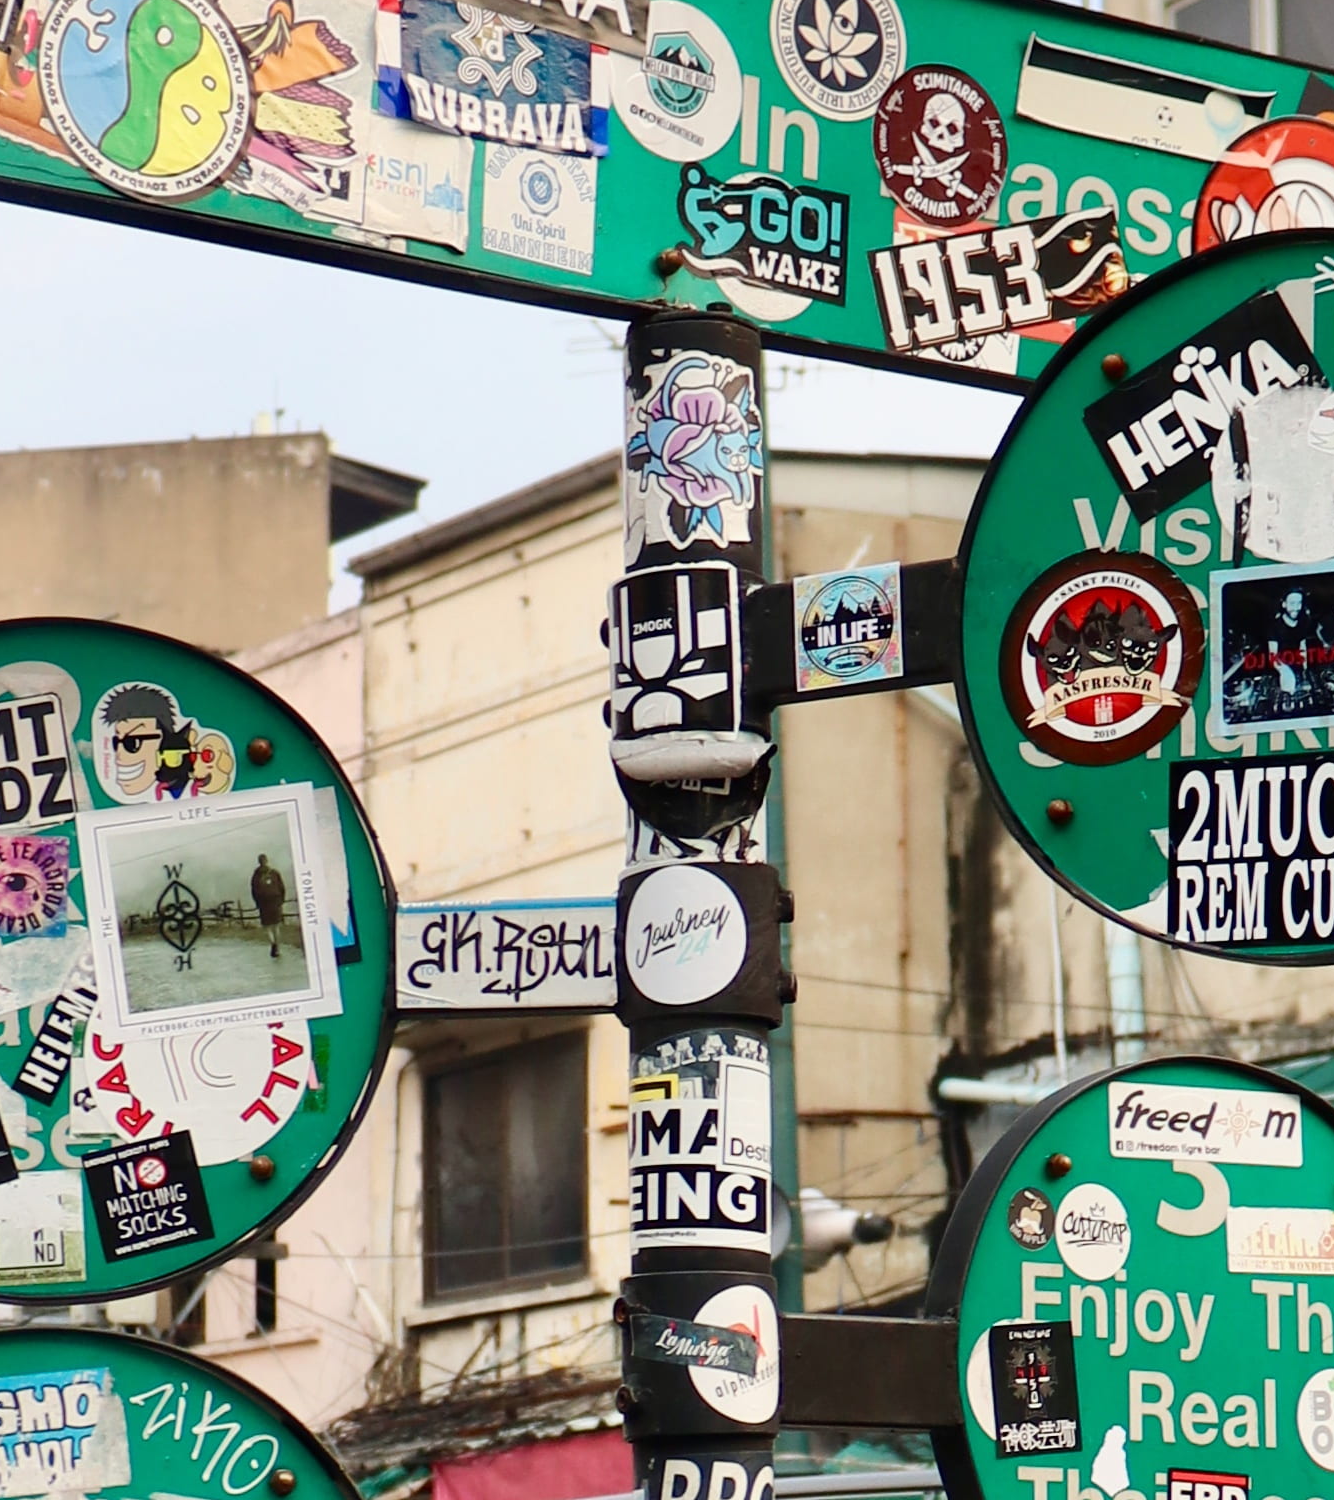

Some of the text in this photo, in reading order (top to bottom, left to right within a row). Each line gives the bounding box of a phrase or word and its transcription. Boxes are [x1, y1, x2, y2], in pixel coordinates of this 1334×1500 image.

[912, 71, 985, 111] SCIMITARRE
[406, 72, 588, 152] DUBRAVA
[740, 74, 821, 181] In
[903, 186, 960, 218] GRANATA
[512, 213, 567, 242] Uni Spirit
[482, 226, 594, 273] MANNHEIM
[749, 246, 841, 297] WAKE
[875, 223, 1052, 352] 1953
[1059, 573, 1137, 601] SANKT PAULI
[633, 617, 674, 636] ZMOGK
[817, 617, 880, 647] IN LIFE
[1052, 672, 1153, 708] AASFRESSER
[1092, 727, 1117, 740] 2010
[179, 806, 212, 821] LIFE
[11, 841, 65, 917] TEARDROP
[301, 870, 316, 926] TONIGHT
[1175, 862, 1269, 945] REM
[102, 914, 114, 938] THE
[637, 903, 731, 969] Journey
[107, 1184, 187, 1219] MATCHING
[118, 1206, 187, 1239] SOCKS
[1021, 1262, 1215, 1361] Enjoy
[666, 1337, 733, 1364] Murga
[1128, 1370, 1278, 1449] Real
[128, 1382, 279, 1494] ZIKO
